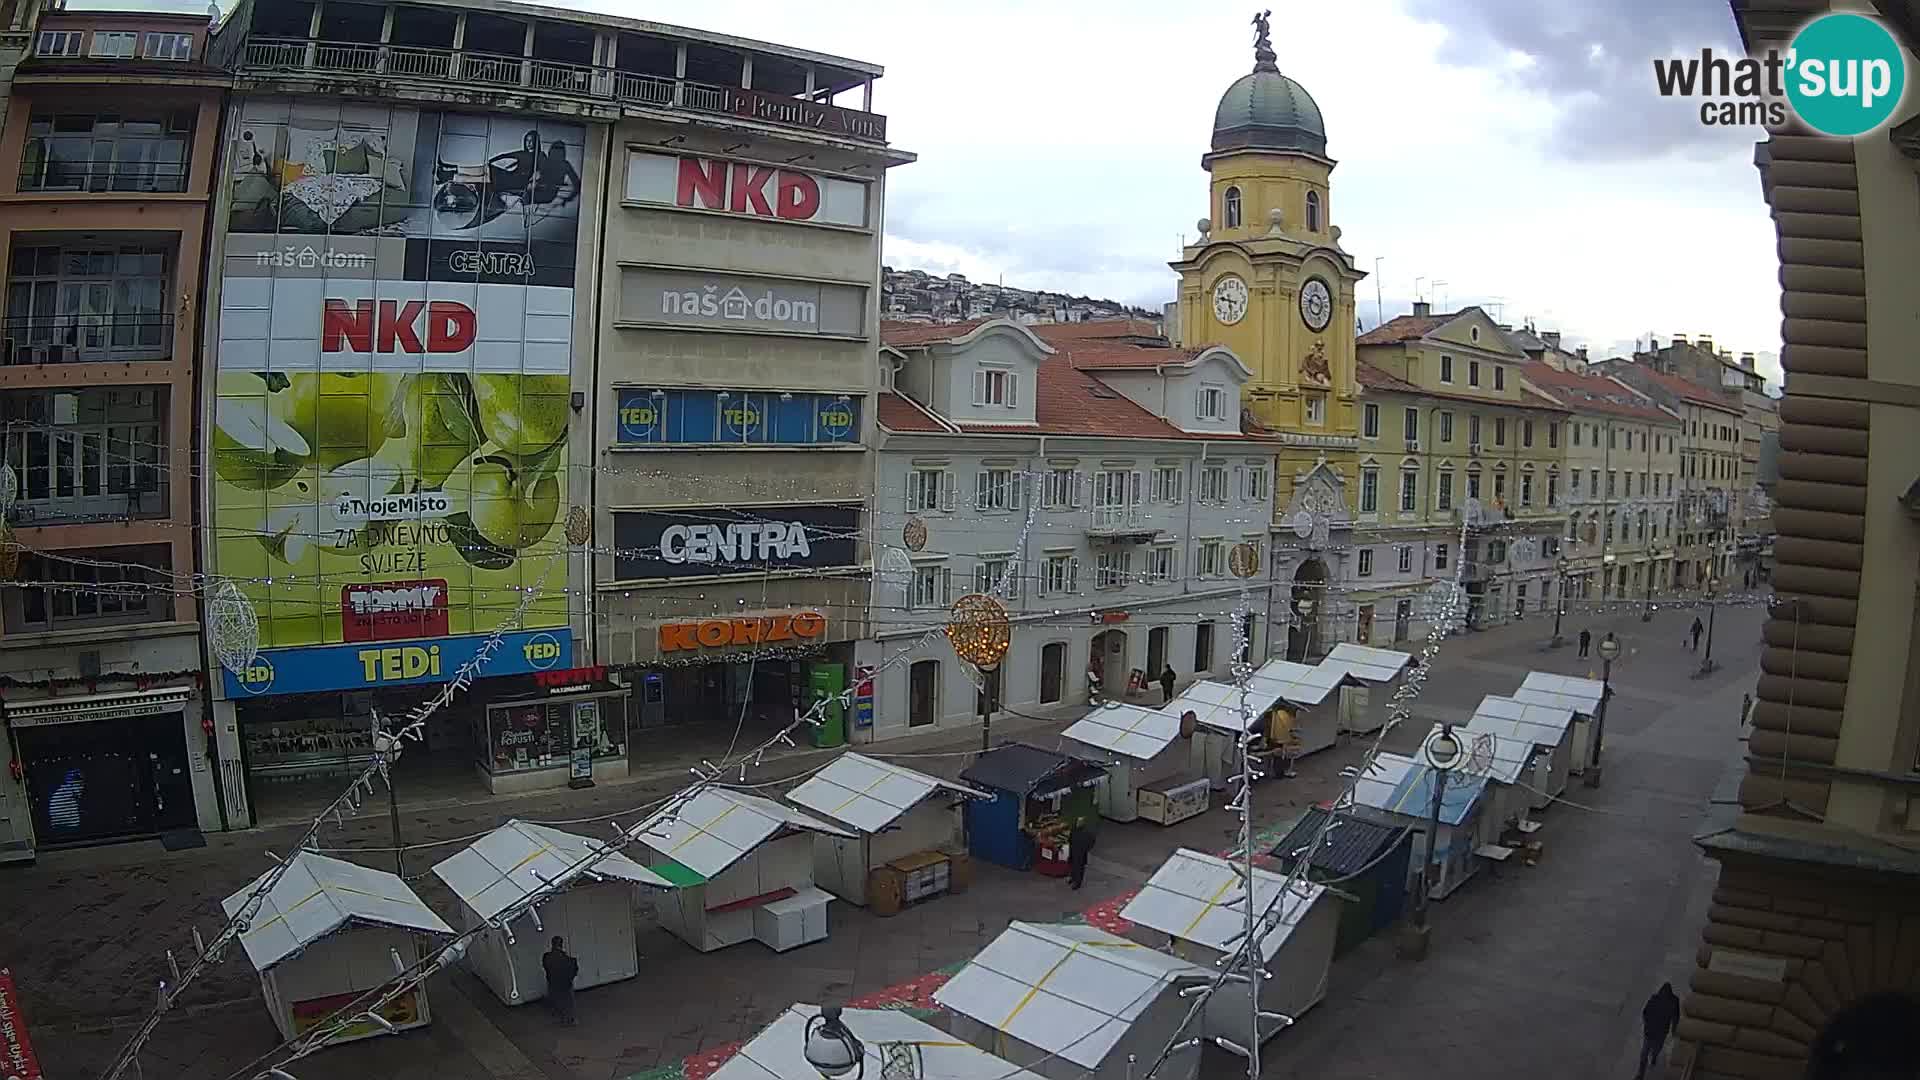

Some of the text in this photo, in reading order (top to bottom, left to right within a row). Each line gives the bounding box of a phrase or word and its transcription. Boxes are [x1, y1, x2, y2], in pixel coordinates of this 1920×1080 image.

[723, 89, 746, 112] Le
[676, 157, 821, 220] NKD
[256, 246, 368, 269] naš dom
[448, 250, 536, 277] CENTRA
[661, 284, 817, 324] naš dom
[321, 297, 478, 355] NKD
[619, 407, 853, 427] TEDi TEDi TEDi
[335, 523, 451, 549] ZA DNEVNO
[660, 521, 811, 565] CENTRA
[360, 546, 427, 576] SVJEŽE
[350, 585, 441, 614] TOMMY
[359, 645, 441, 682] TEDi
[523, 643, 561, 661] TEDi
